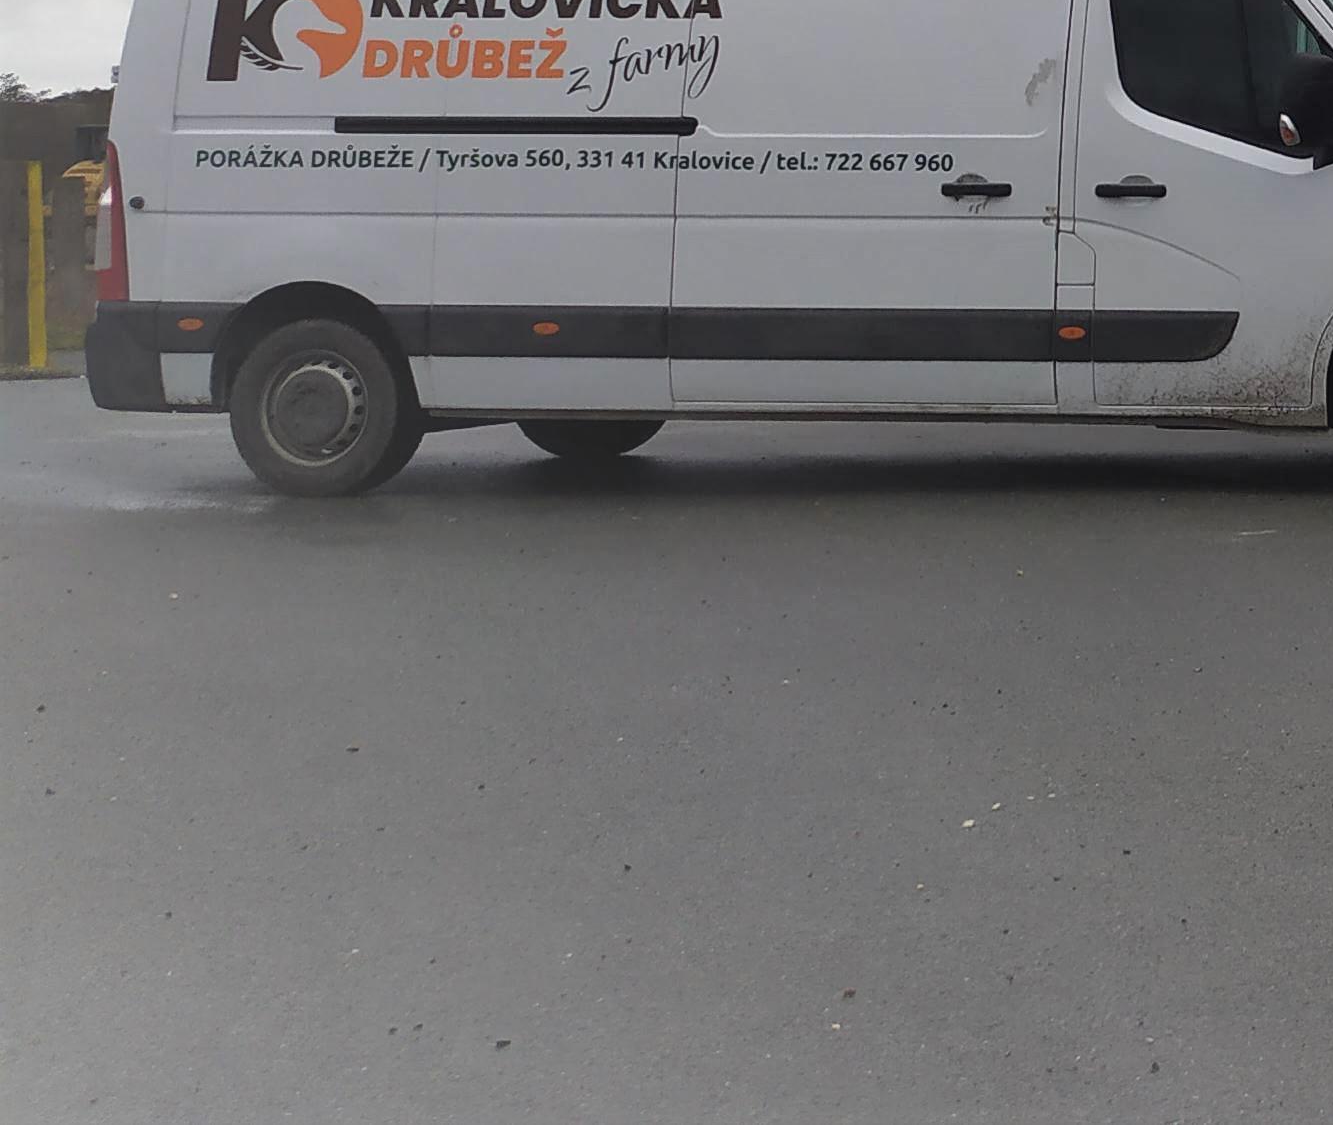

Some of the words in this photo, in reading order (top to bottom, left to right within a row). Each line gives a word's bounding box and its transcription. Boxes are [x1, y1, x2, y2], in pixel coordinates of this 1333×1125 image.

[362, 23, 568, 79] DRŮBEŽ
[566, 66, 592, 95] z
[586, 35, 720, 113] farmy
[195, 144, 304, 169] PORÁŽKA
[311, 144, 414, 169] DRŮBEŽE
[418, 147, 432, 173] /
[435, 147, 519, 172] Tyršova
[525, 149, 571, 171] 560,
[576, 150, 613, 170] 331
[620, 151, 646, 170] 41
[653, 150, 756, 172] Kralovice
[759, 150, 772, 174] /
[776, 152, 819, 171] tel.:
[824, 153, 864, 172] 722
[868, 153, 909, 172] 667
[914, 153, 955, 172] 960
